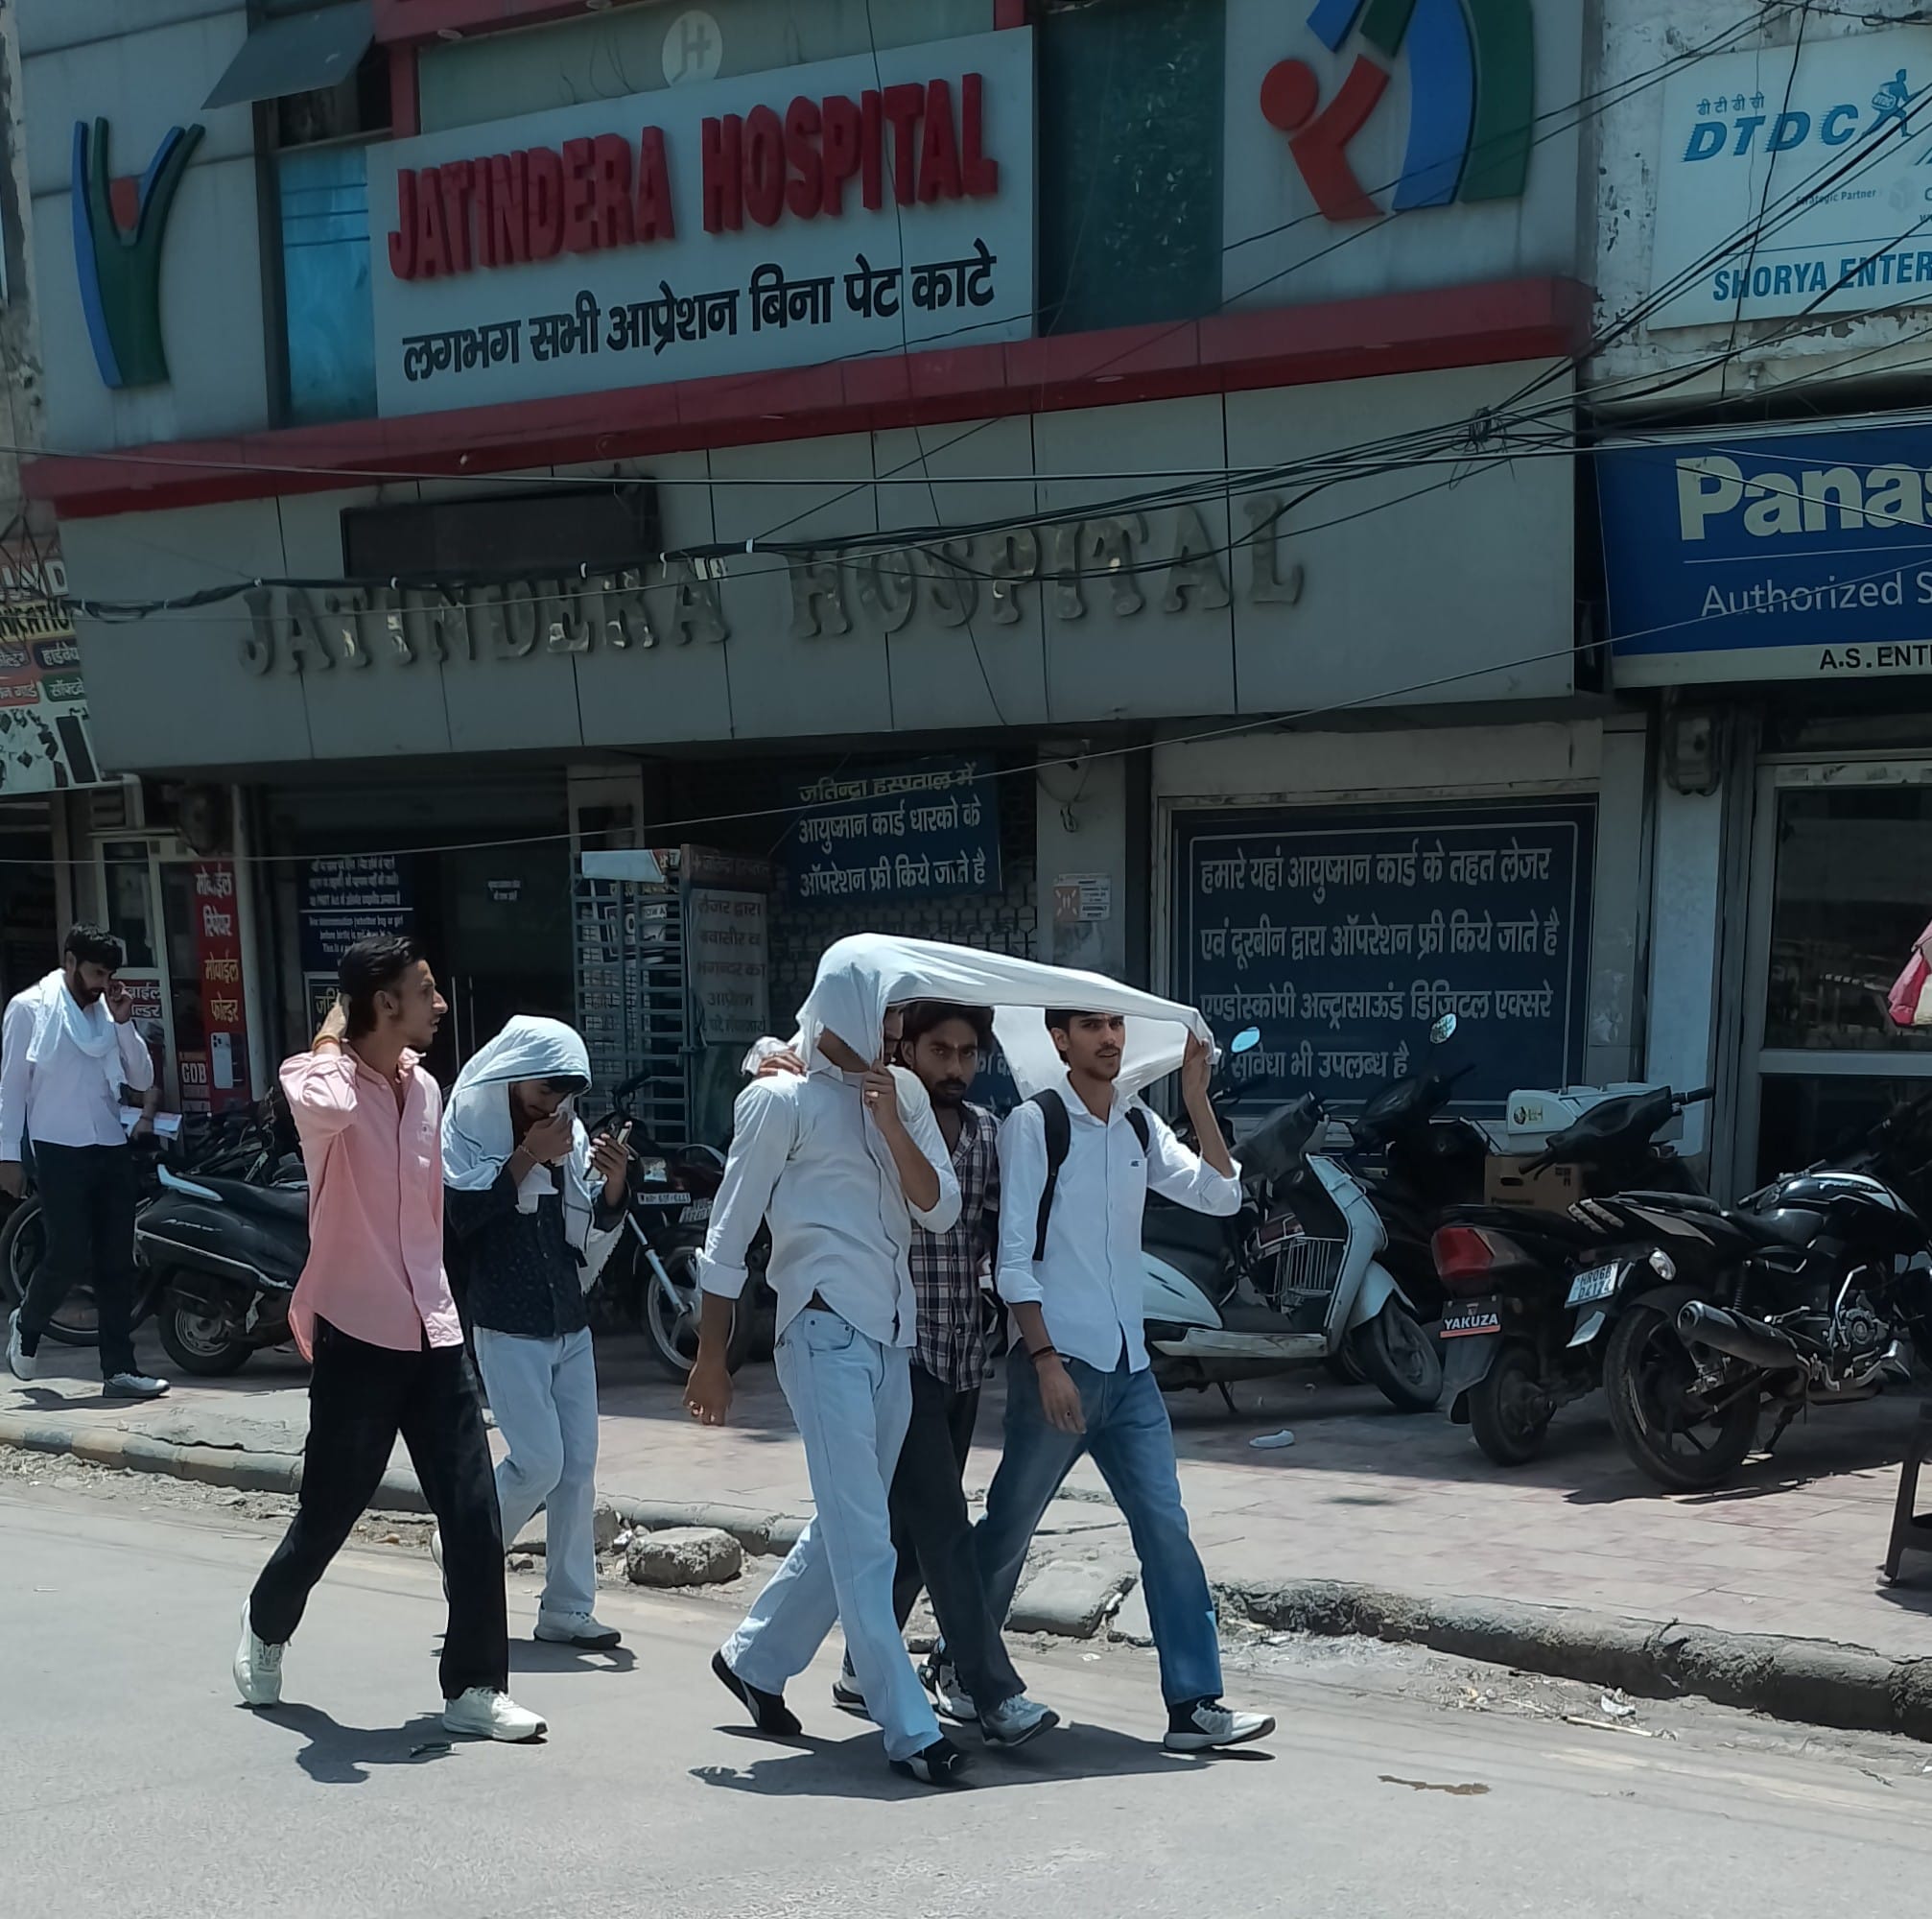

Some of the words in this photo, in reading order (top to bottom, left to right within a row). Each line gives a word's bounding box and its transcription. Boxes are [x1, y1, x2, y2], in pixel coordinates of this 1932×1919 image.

[1682, 104, 1859, 162] DTDC
[388, 126, 675, 280] JATINDERA
[701, 73, 999, 233] HOSPITAL
[1841, 189, 1876, 201] Partner
[1713, 261, 1827, 301] SHORYA
[1840, 251, 1932, 289] ENTER
[403, 320, 521, 381] लगभग
[529, 291, 601, 361] सभी
[607, 280, 739, 355] आप्रेशन
[749, 264, 834, 330] बिना
[844, 254, 901, 319] पेट
[911, 238, 997, 310] काटे
[1676, 456, 1932, 540] Pana
[239, 560, 731, 676] JATINDERA
[788, 494, 1304, 638] HOSPITAL
[1702, 571, 1902, 617] Authorized
[1820, 644, 1932, 669] A.S.ENT
[798, 814, 867, 854] आयुष्मान
[871, 798, 905, 837] कार्ड
[962, 793, 981, 827] के
[799, 861, 867, 896] ऑपरेशन
[895, 852, 930, 888] किये
[932, 849, 969, 883] जाते
[973, 846, 986, 884] है
[1200, 846, 1246, 893] हमारे
[1250, 844, 1284, 890] यहां
[1287, 854, 1372, 904] आयुष्मान
[1376, 838, 1419, 887] कार्ड
[1423, 839, 1445, 883] के
[1449, 850, 1496, 886] तहत
[1500, 837, 1552, 883] लेजर
[1200, 916, 1227, 960] एवं
[1231, 913, 1287, 970] दूरबीन
[1290, 925, 1328, 960] द्वारा
[1331, 911, 1414, 956] ऑपरेशन
[1449, 909, 1493, 953] किये
[1496, 909, 1539, 953] जाते
[1543, 906, 1560, 956] है
[1410, 979, 1492, 1020] डिजिटल
[1495, 979, 1554, 1019] एक्सरे
[1291, 1040, 1314, 1078] भी
[1318, 1052, 1389, 1079] उपलब्ध
[1392, 1040, 1411, 1078] है
[1444, 1313, 1498, 1331] YAKUZA
